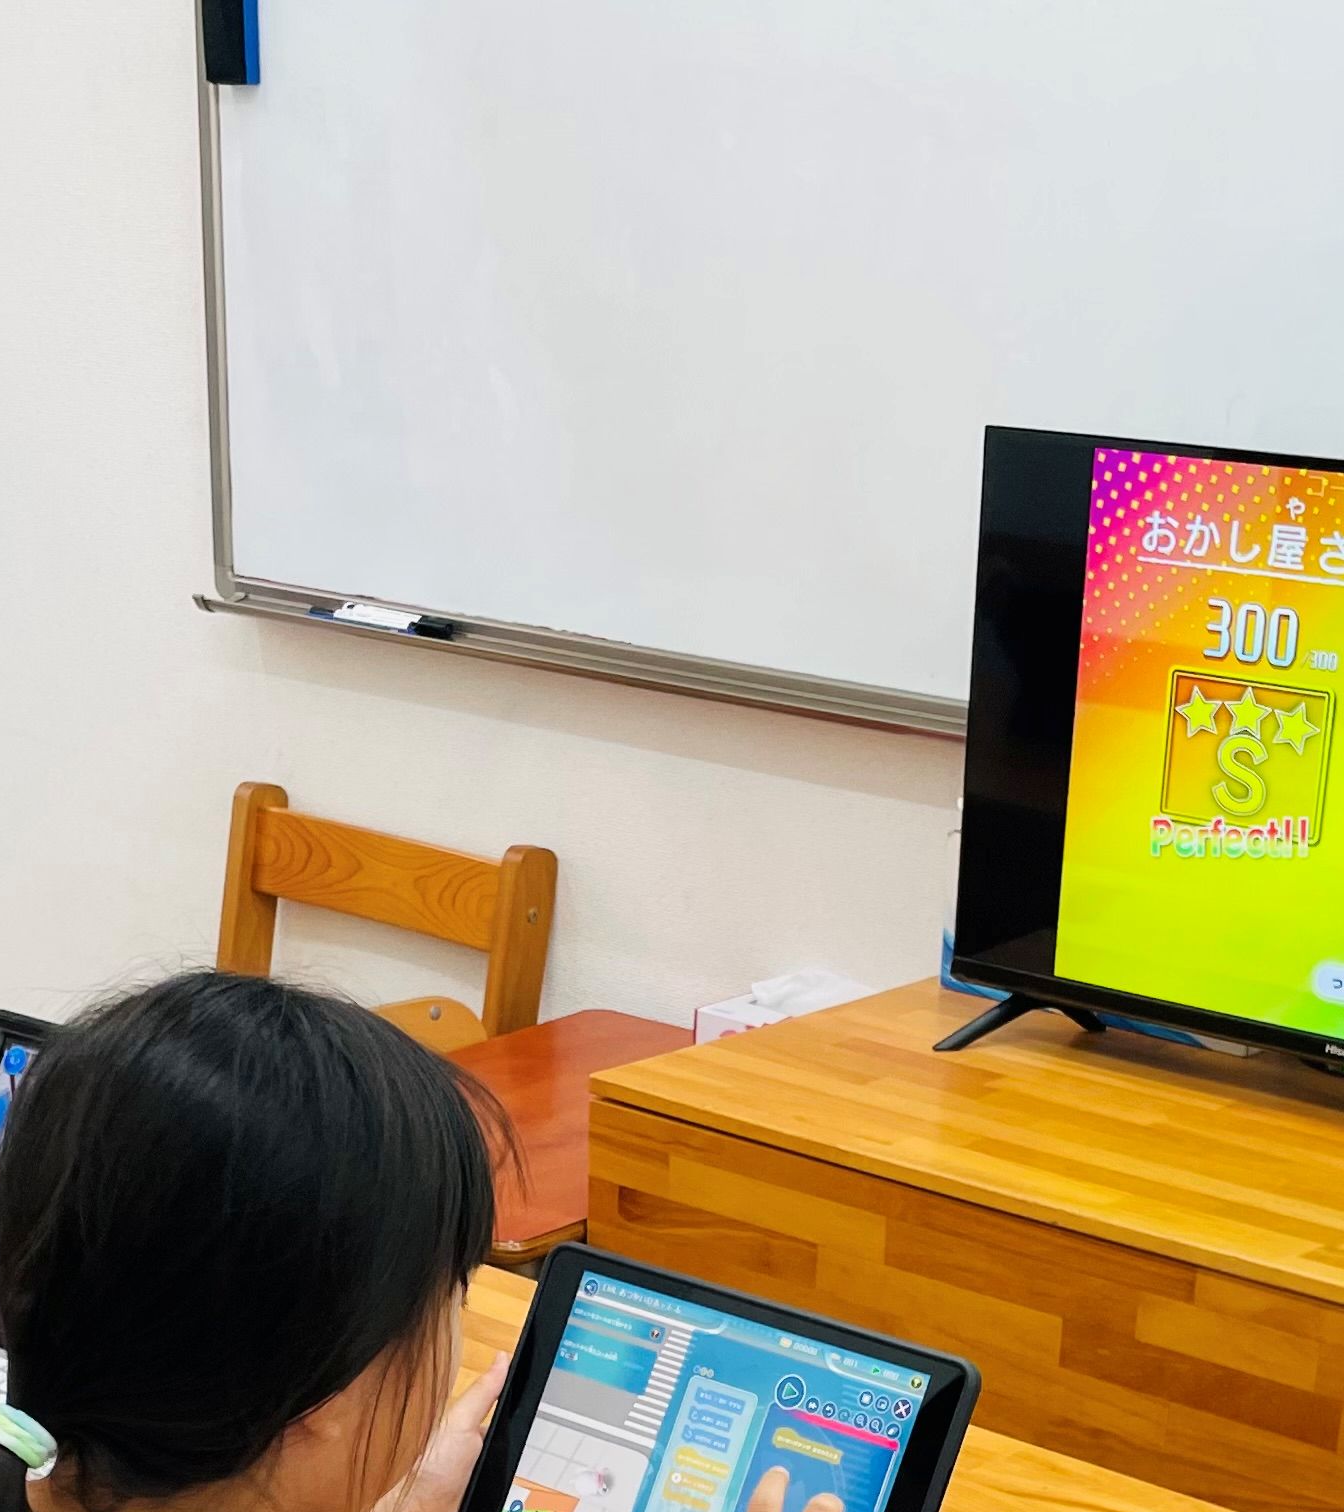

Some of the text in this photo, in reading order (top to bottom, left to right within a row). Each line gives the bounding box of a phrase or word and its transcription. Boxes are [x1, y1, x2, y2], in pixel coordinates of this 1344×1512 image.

[1287, 497, 1306, 518] や
[1203, 597, 1301, 668] 300
[1211, 734, 1269, 817] S
[1150, 815, 1311, 860] Perfect!!
